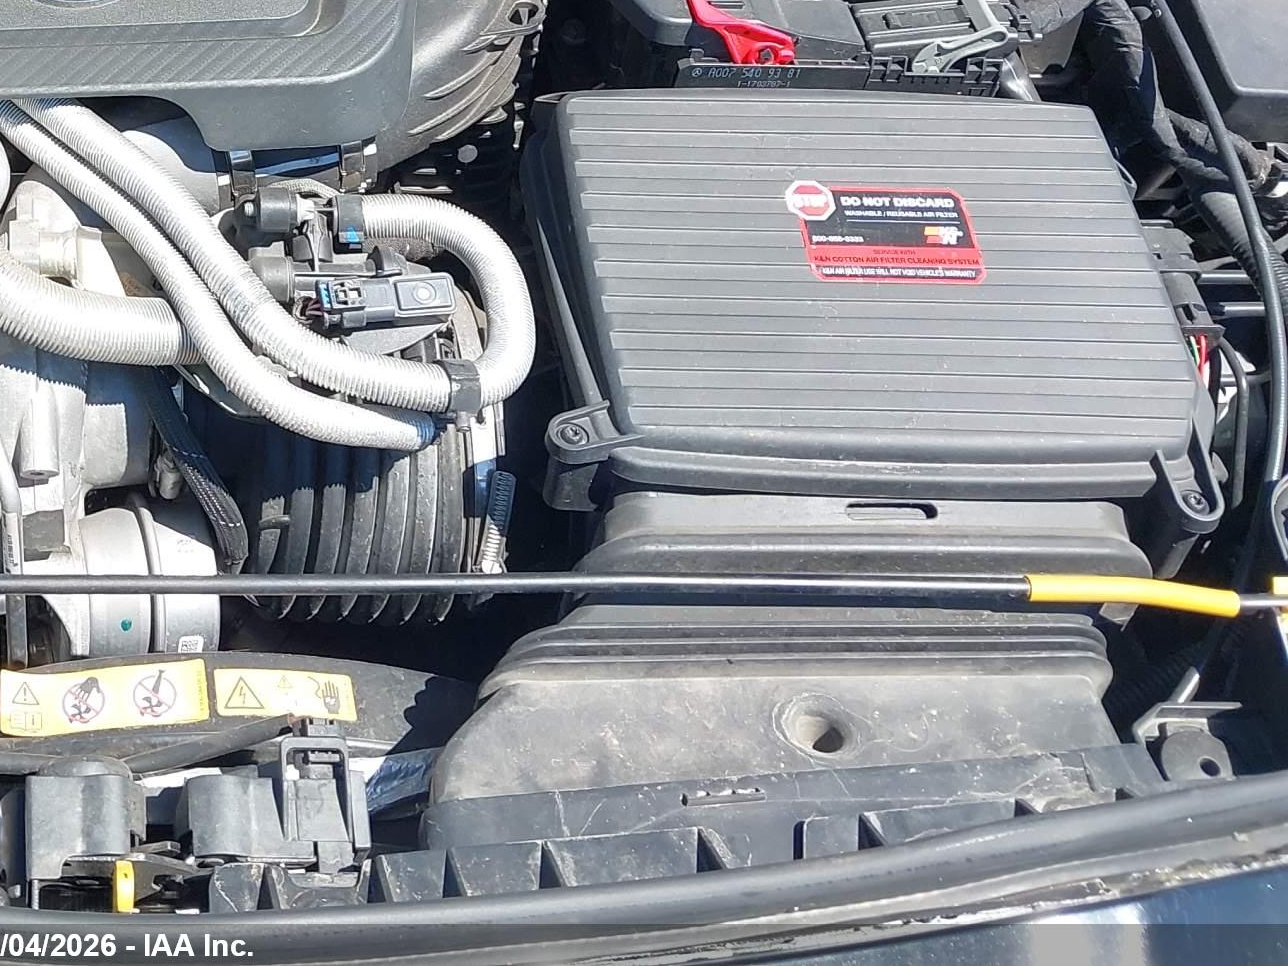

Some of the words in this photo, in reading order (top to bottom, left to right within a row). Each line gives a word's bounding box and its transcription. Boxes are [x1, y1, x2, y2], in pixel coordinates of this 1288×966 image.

[708, 67, 736, 79] A007
[741, 68, 762, 79] 540
[767, 68, 782, 79] 93
[787, 68, 801, 79] 81
[840, 196, 861, 207] DO
[862, 196, 891, 208] NOT
[892, 197, 955, 209] DISCARD
[844, 210, 882, 218] WASHABLE
[886, 210, 922, 218] REUSABLE
[922, 211, 934, 219] AIR
[934, 211, 959, 219] FILTER
[814, 255, 831, 263] K&N
[907, 257, 947, 265] CLEANING
[948, 258, 980, 266] SYSTEM
[889, 268, 901, 276] NOT
